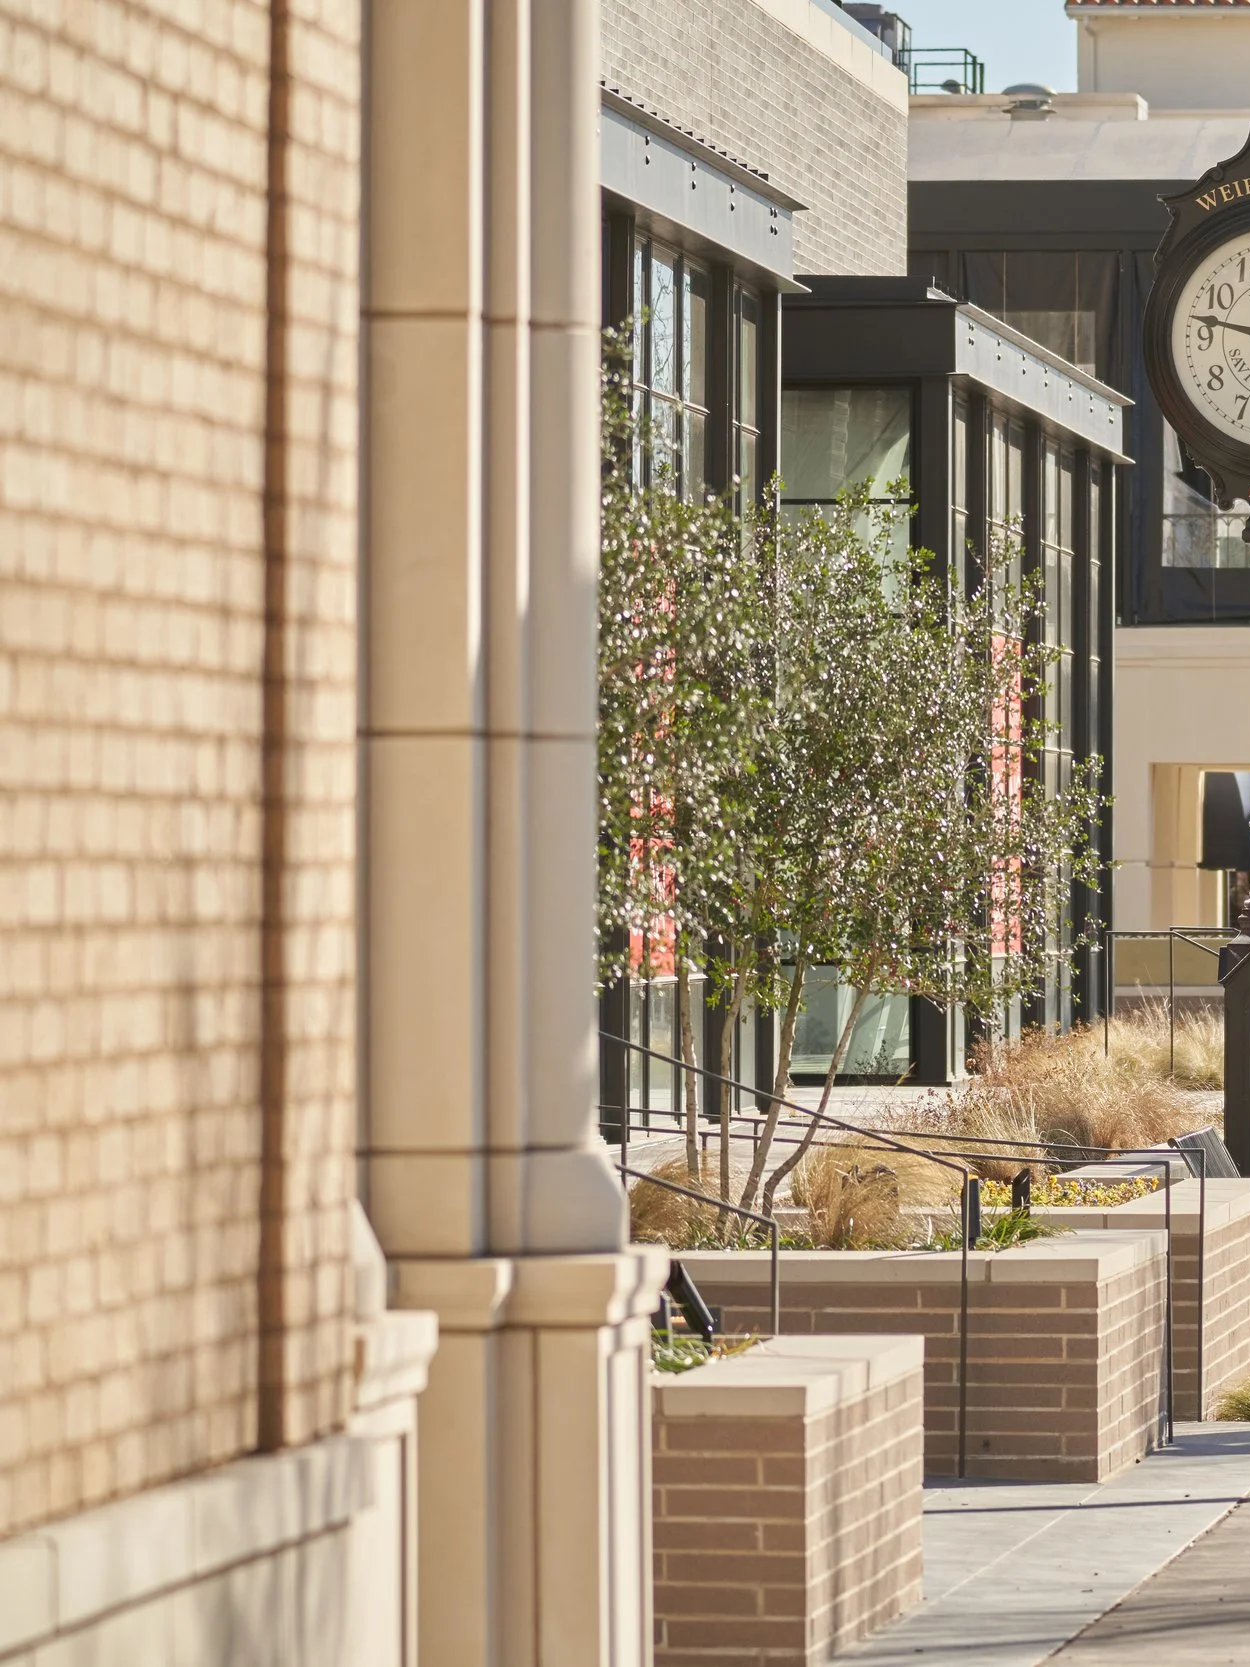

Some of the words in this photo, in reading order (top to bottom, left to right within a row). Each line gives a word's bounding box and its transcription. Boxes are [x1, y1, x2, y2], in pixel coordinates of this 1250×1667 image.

[1205, 282, 1235, 310] 10
[1197, 325, 1214, 352] 9
[1207, 364, 1225, 392] 8
[1234, 393, 1250, 421] 7
